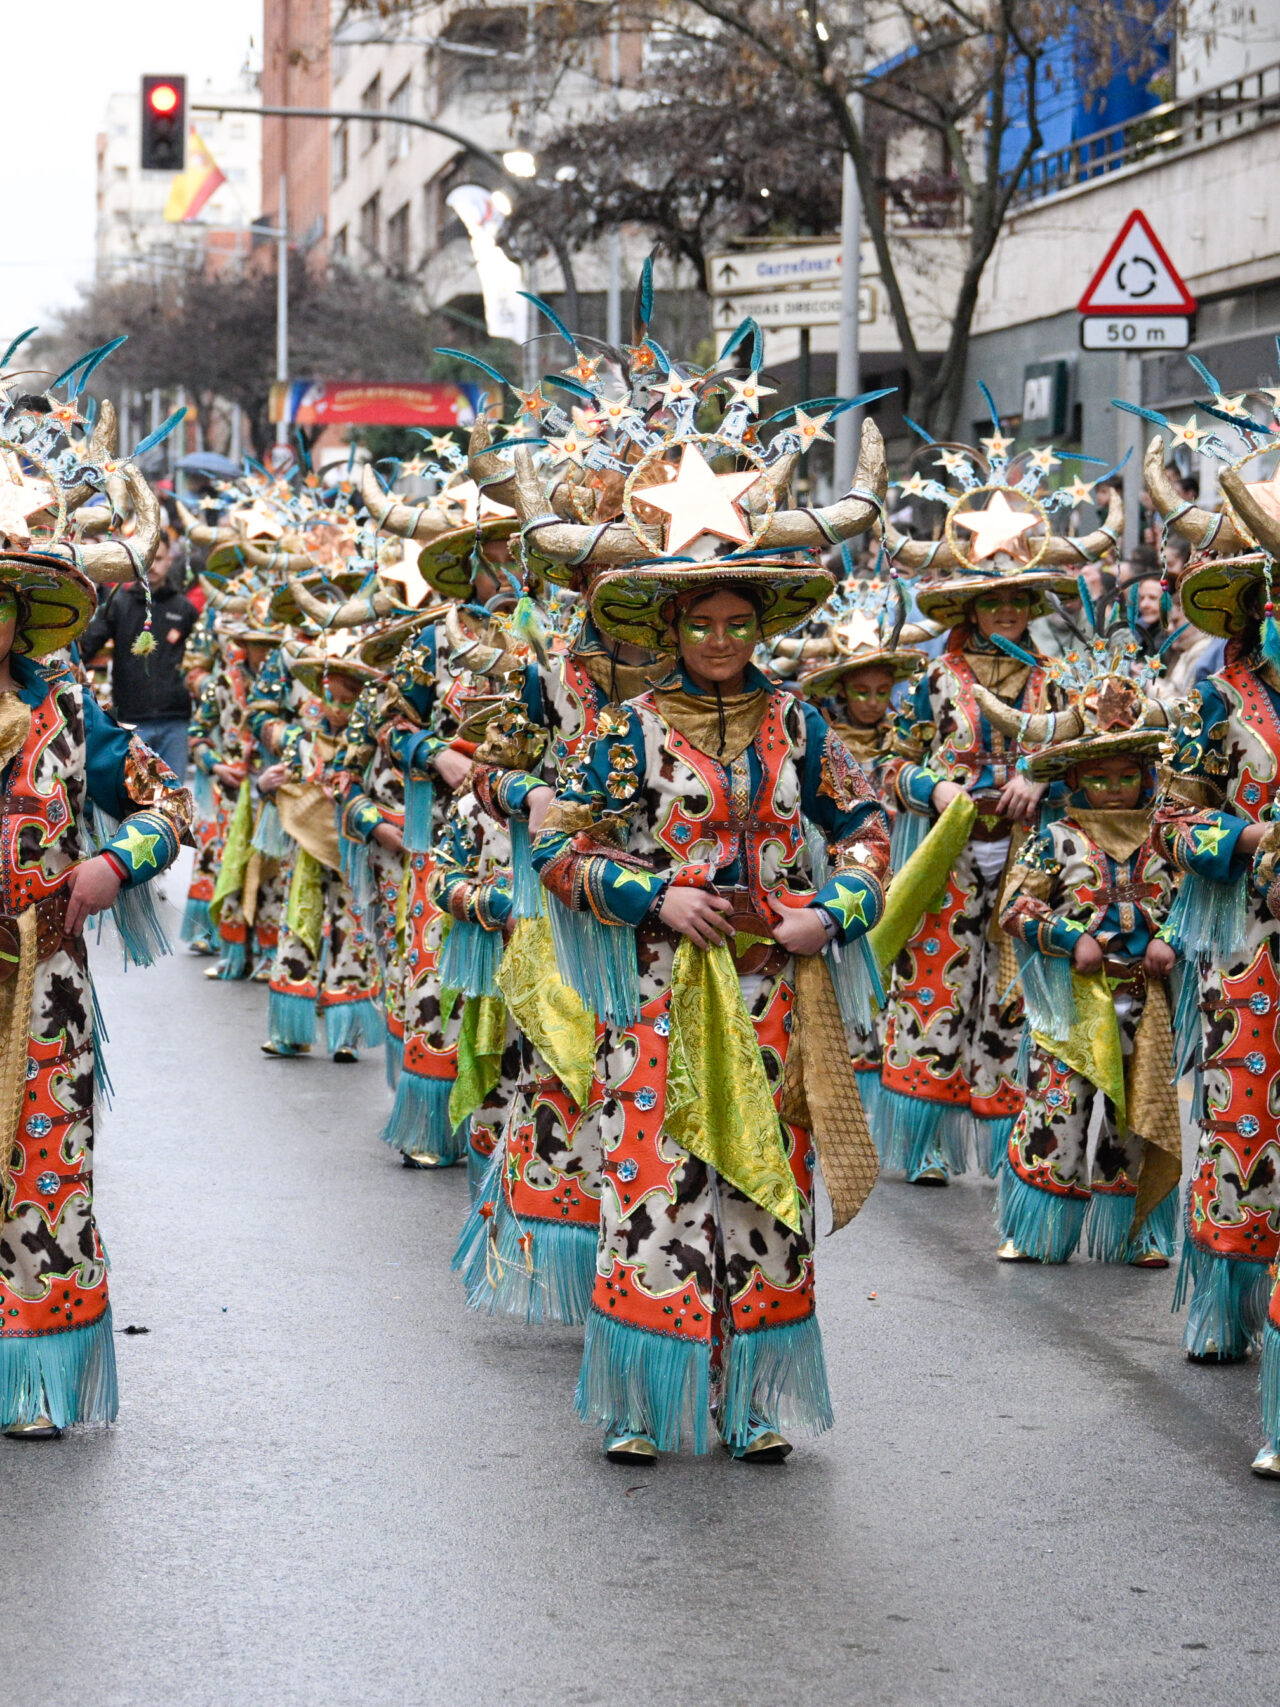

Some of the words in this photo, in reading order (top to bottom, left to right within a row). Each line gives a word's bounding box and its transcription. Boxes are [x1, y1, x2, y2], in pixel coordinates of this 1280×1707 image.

[757, 258, 832, 276] Carrefour
[1107, 325, 1136, 341] 50
[1147, 327, 1165, 341] m
